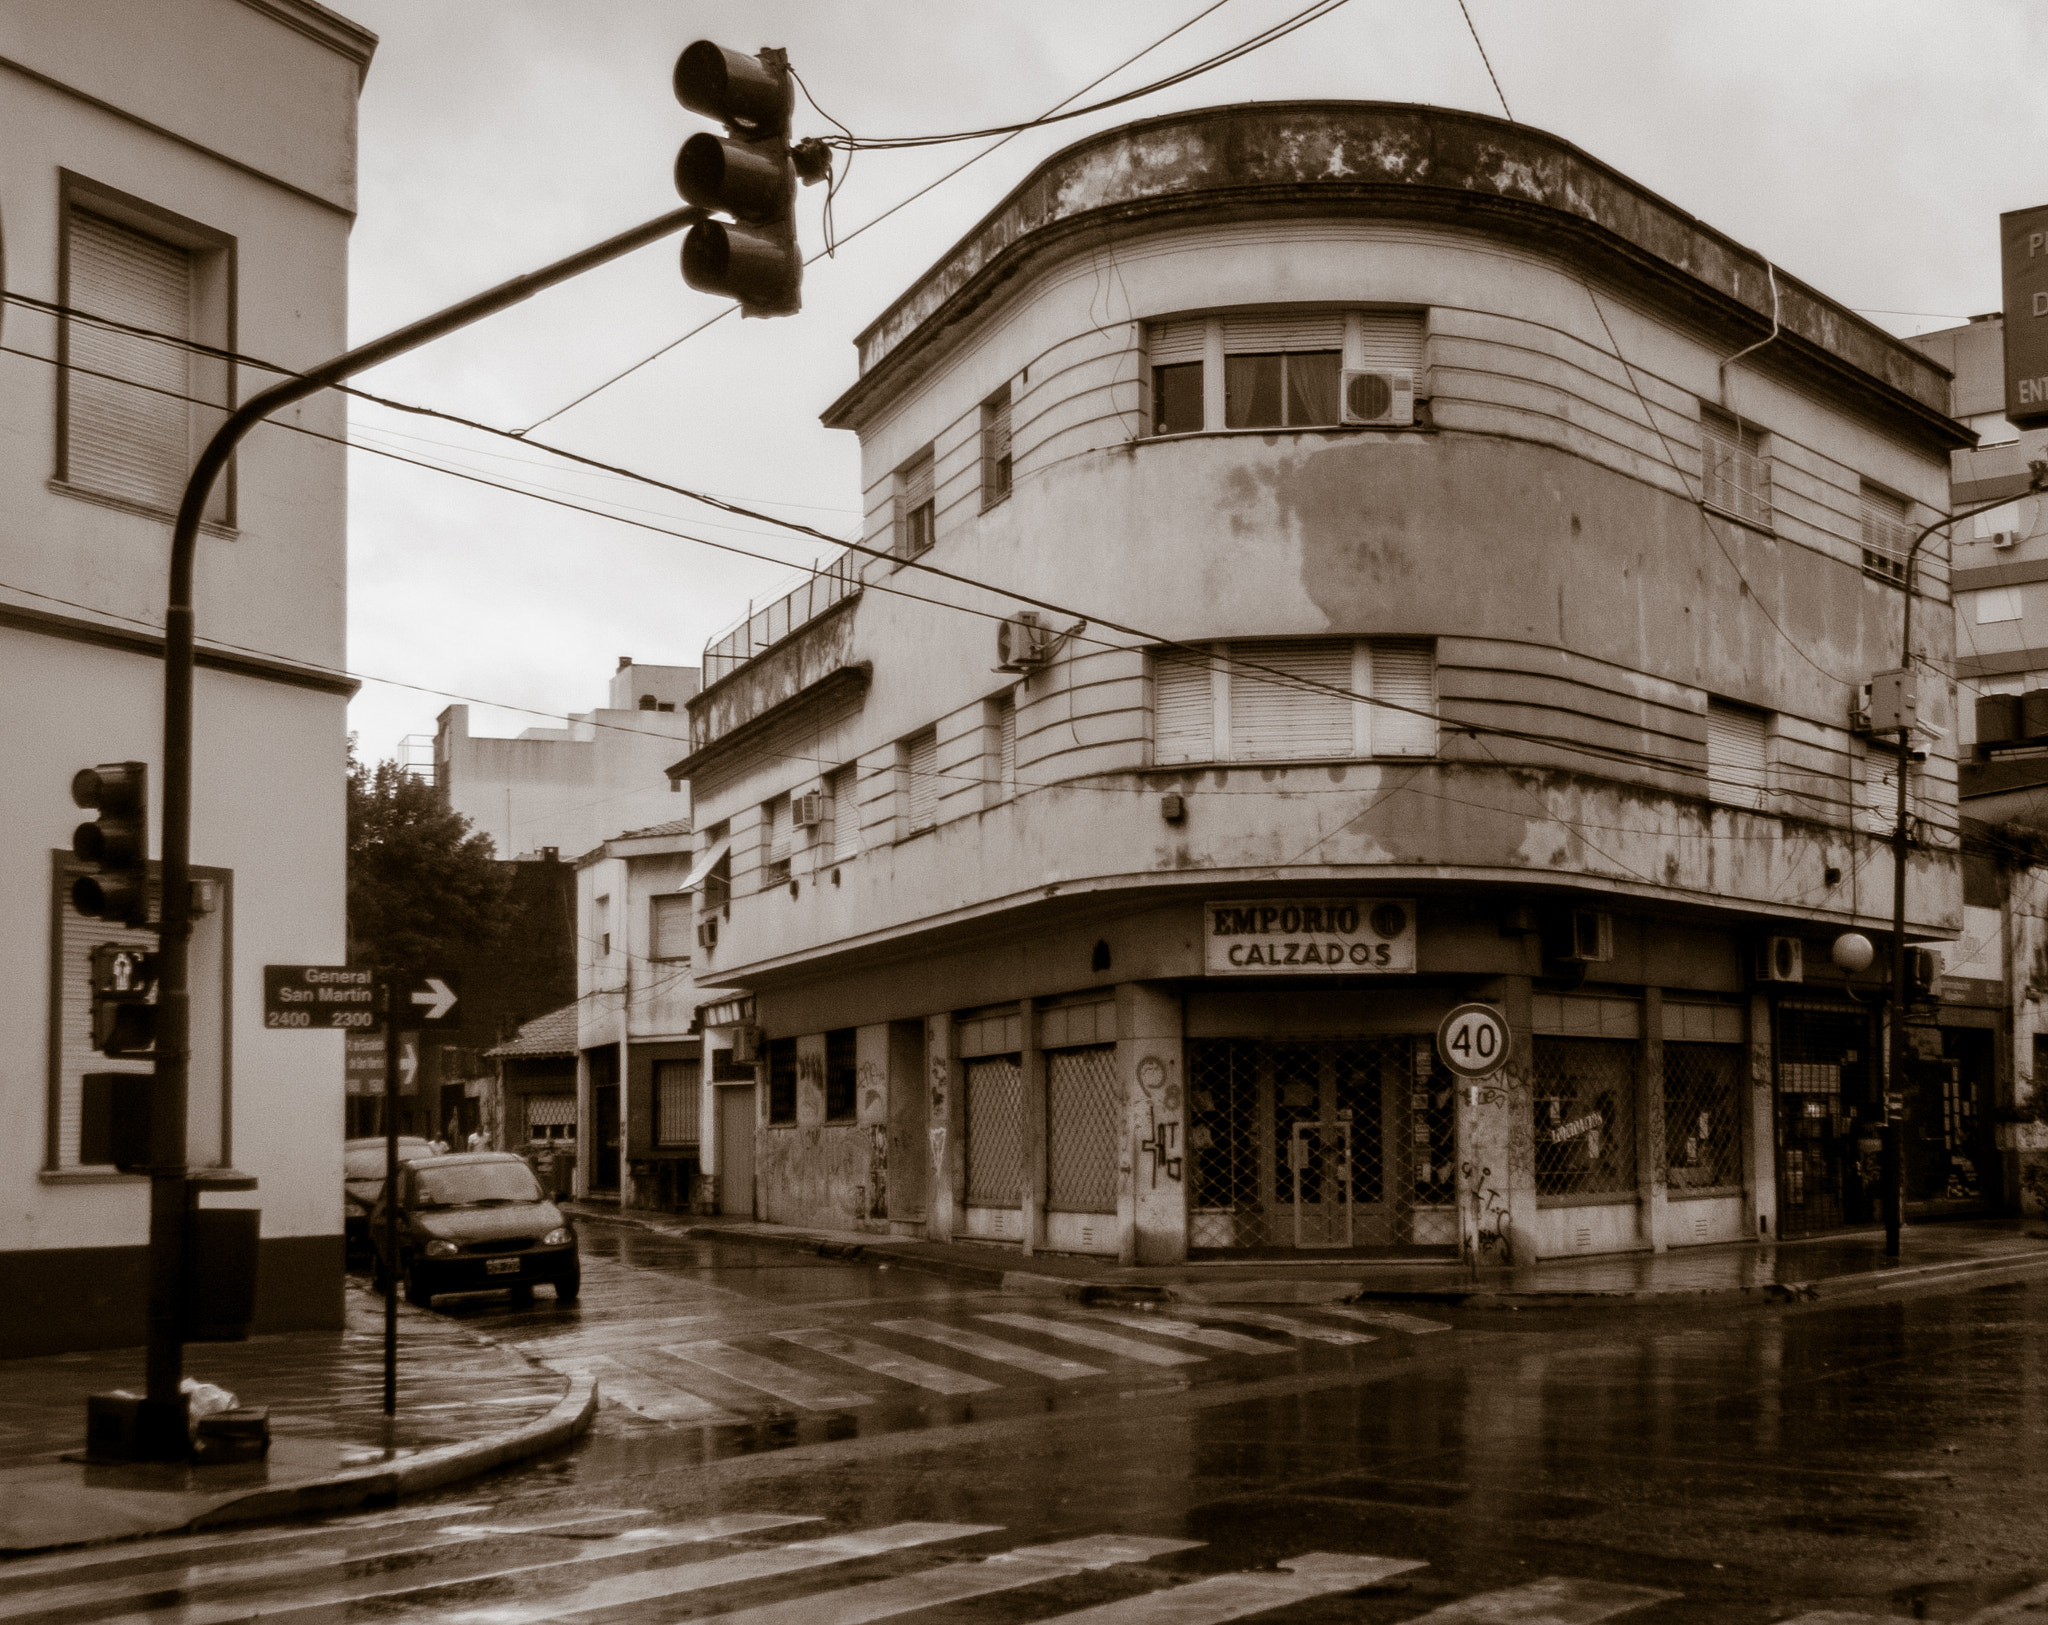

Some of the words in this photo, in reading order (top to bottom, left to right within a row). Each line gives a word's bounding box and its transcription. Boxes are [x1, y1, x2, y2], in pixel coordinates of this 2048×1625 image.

[2028, 232, 2048, 259] P
[1211, 904, 1359, 936] EMPORIO
[1228, 943, 1392, 966] CALZADOS
[305, 968, 372, 984] General
[280, 987, 314, 1002] San
[268, 1012, 311, 1027] 2400
[331, 1012, 373, 1027] 2300
[1451, 1023, 1496, 1058] 40
